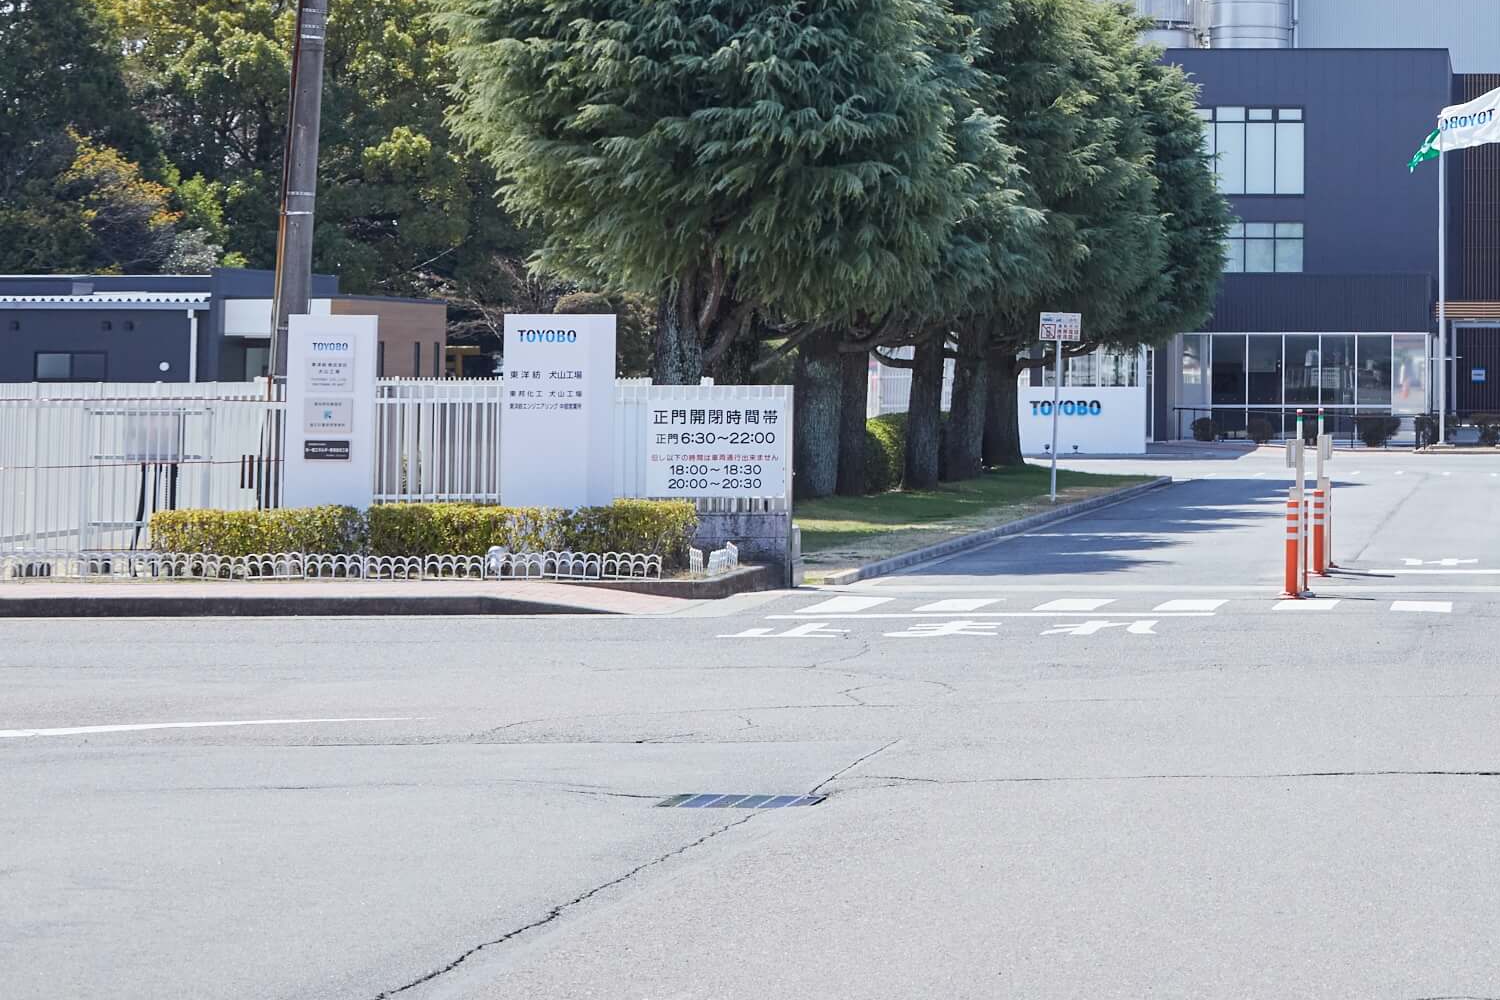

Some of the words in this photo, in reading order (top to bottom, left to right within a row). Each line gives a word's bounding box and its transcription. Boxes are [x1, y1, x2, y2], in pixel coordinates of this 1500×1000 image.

[517, 329, 577, 343] TOYOBO
[312, 342, 349, 351] TOYOBO
[1029, 400, 1102, 416] TOYOBO
[653, 409, 778, 425] 正門開閉時間帯
[716, 620, 1159, 637] 止まれ
